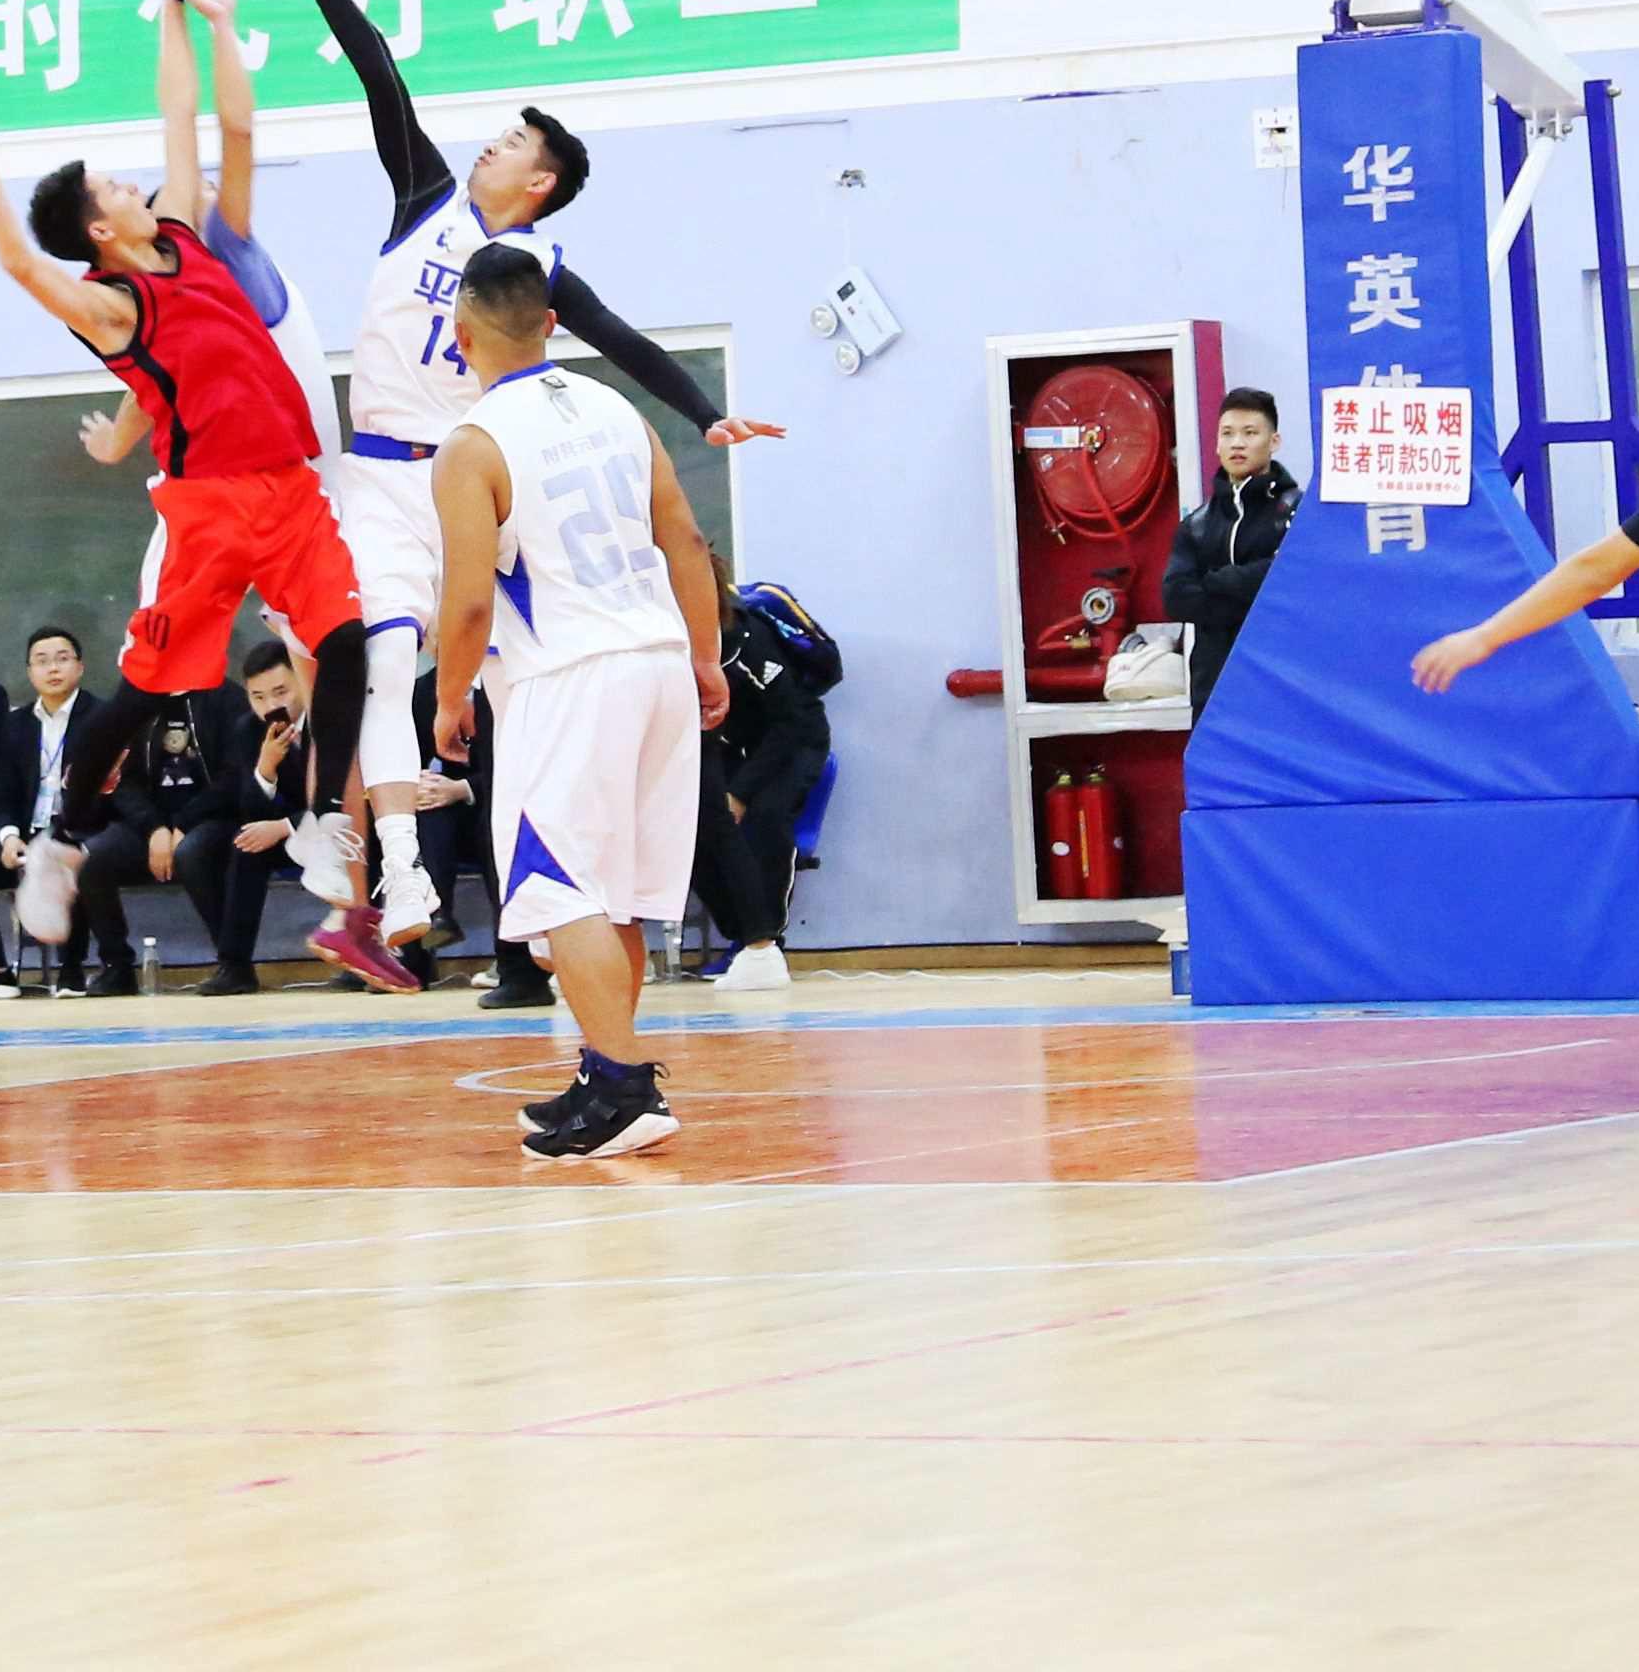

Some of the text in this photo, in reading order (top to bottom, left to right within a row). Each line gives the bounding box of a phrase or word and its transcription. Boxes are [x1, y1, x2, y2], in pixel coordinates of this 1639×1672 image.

[1342, 144, 1427, 554] 华英育
[1333, 399, 1463, 437] 禁止吸烟
[1331, 441, 1463, 476] 违者罚款50元
